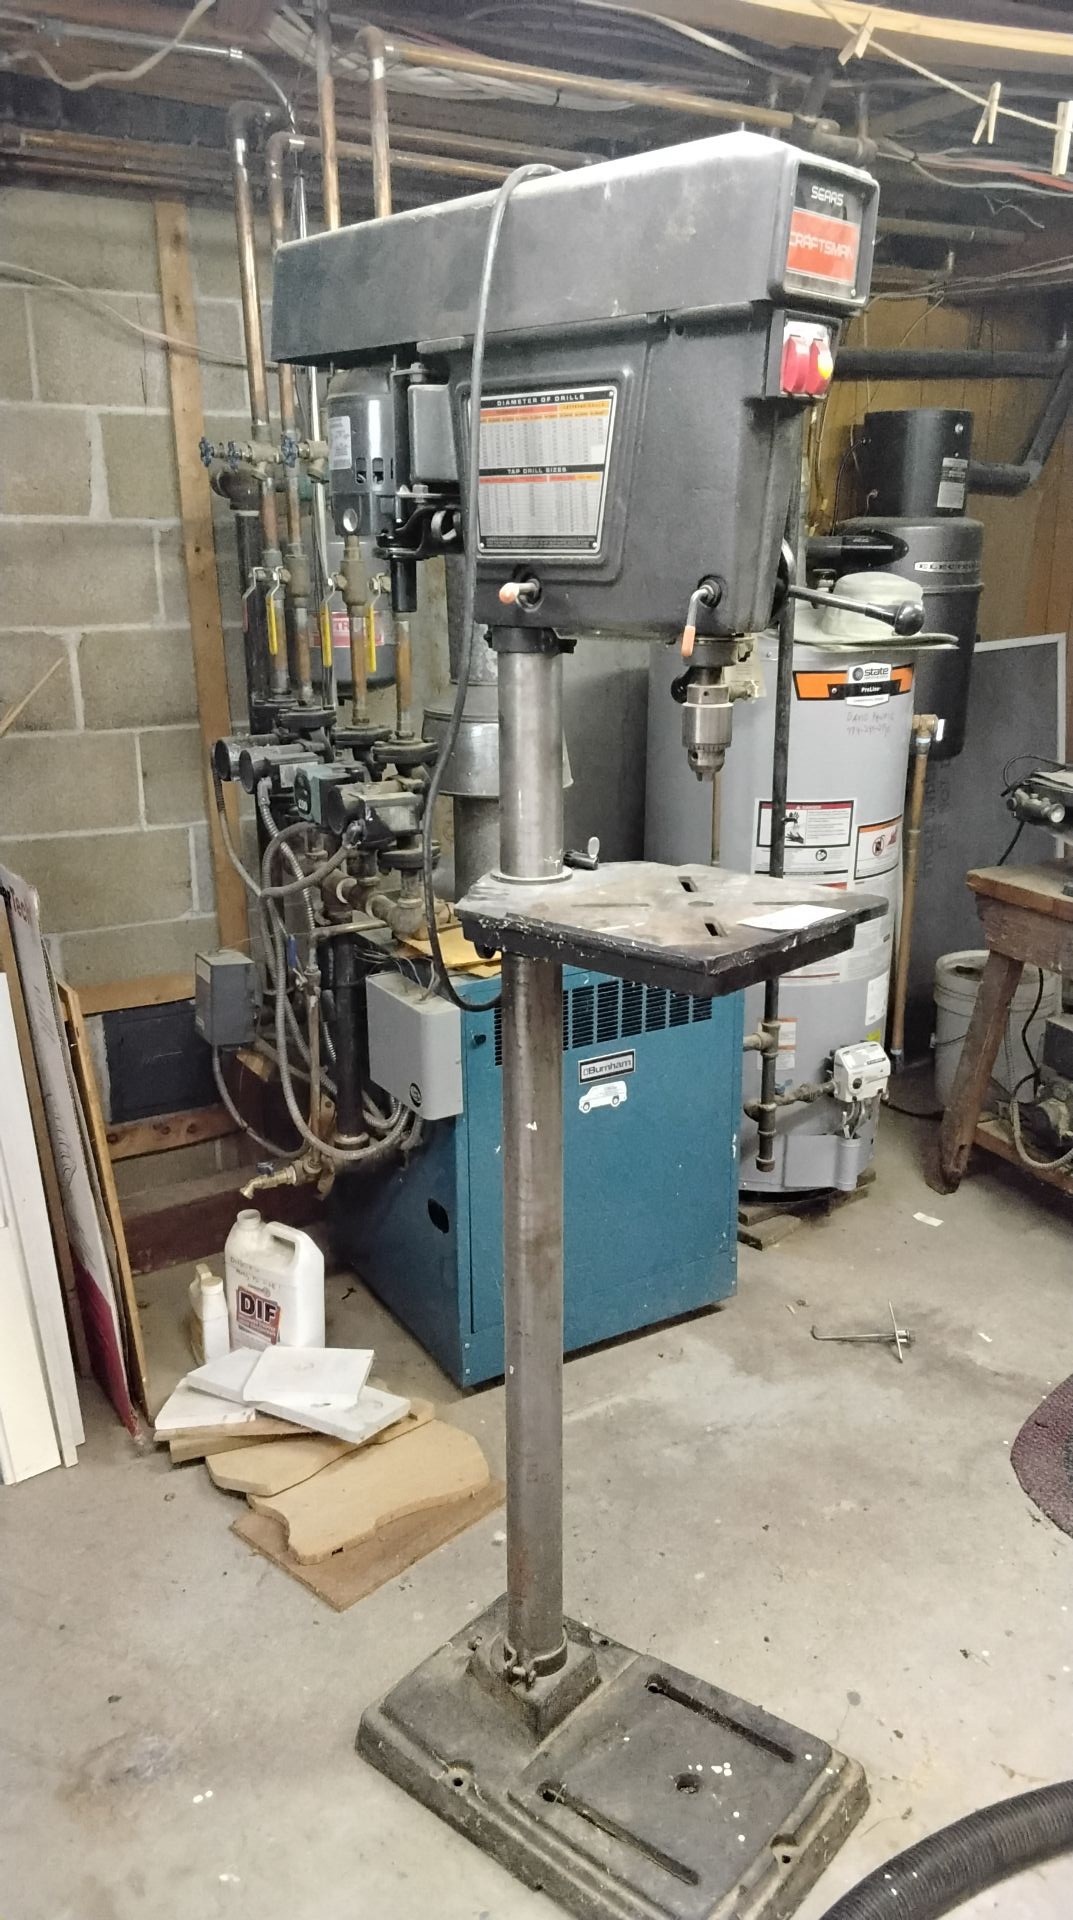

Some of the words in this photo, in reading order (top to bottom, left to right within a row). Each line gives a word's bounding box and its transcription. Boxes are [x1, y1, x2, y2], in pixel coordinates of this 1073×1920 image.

[810, 184, 844, 207] SEARS
[789, 230, 855, 258] CRAFTSMAN
[496, 397, 537, 406] DIAMETER
[864, 667, 889, 677] state
[588, 1059, 631, 1074] Burnham
[239, 1290, 277, 1324] DIF
